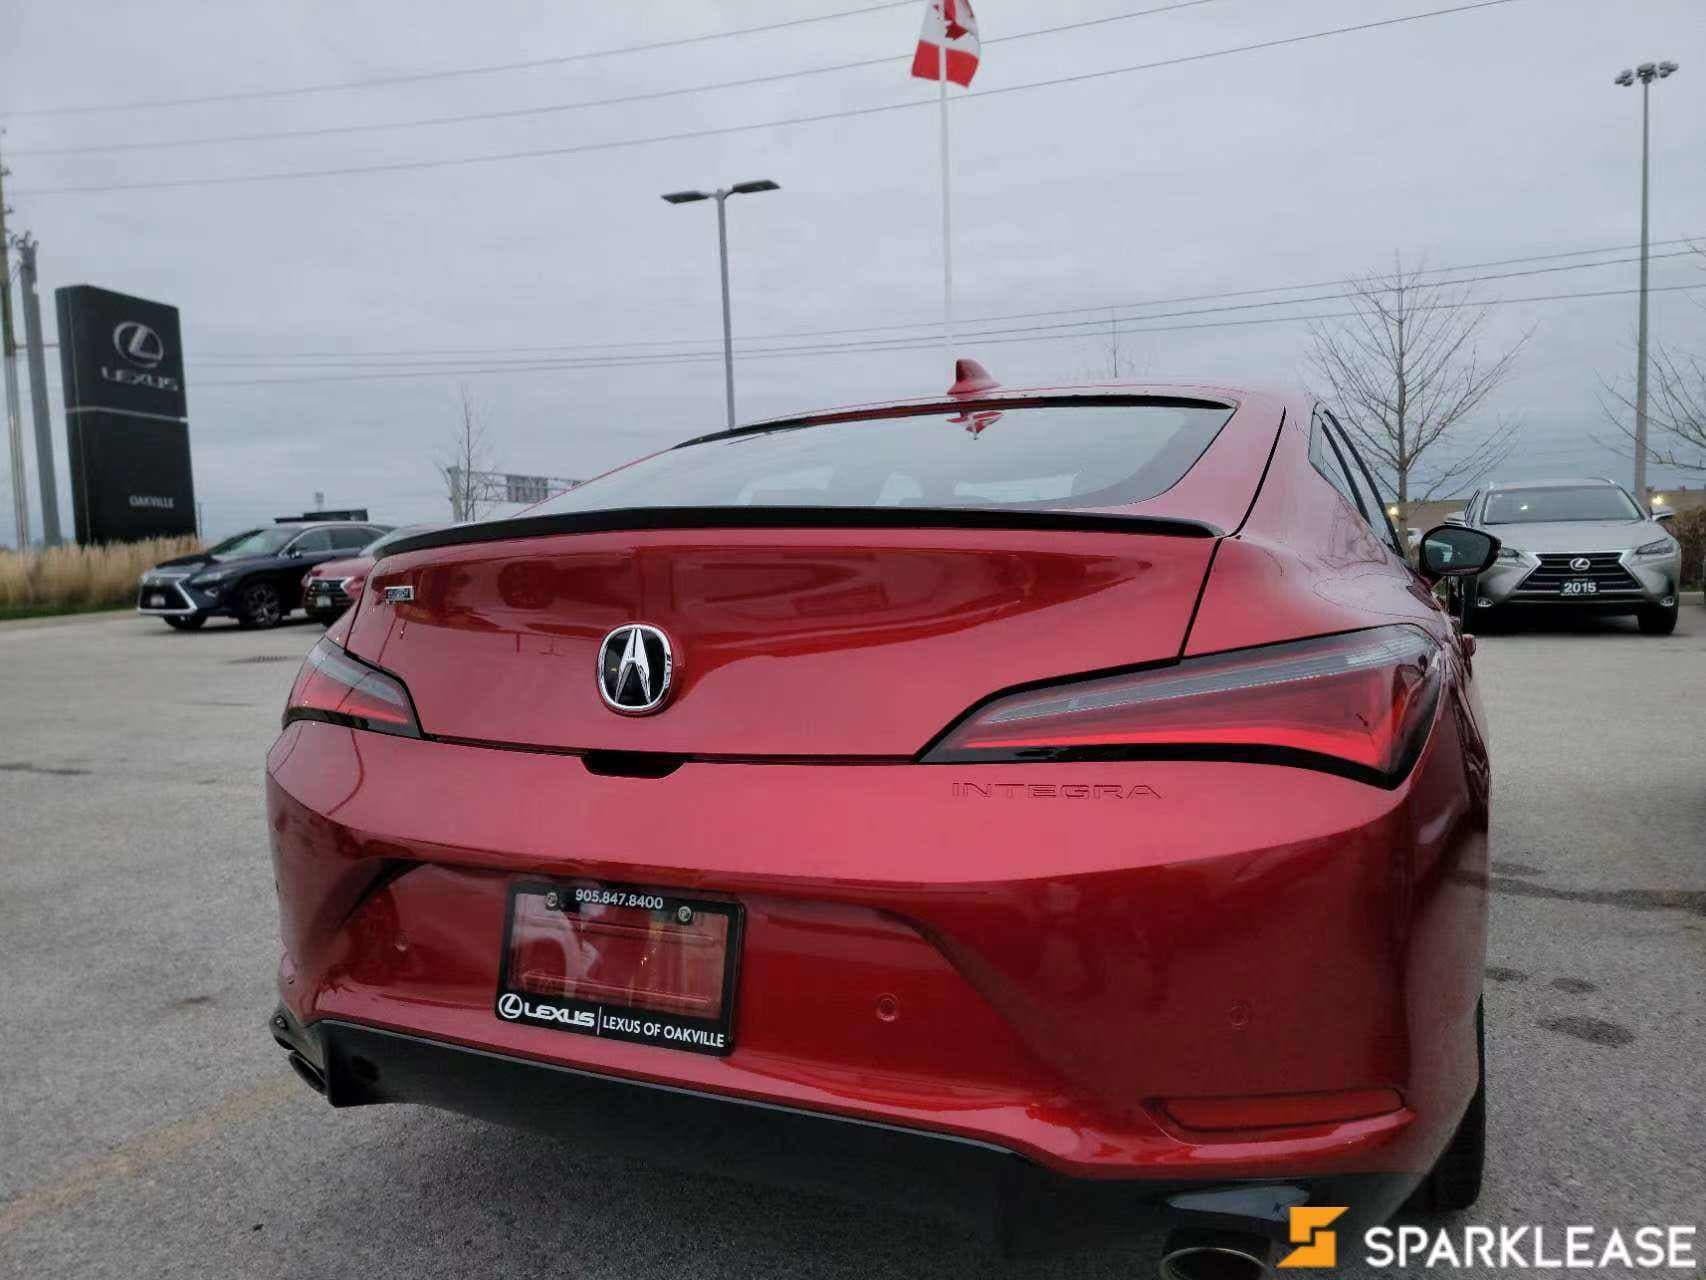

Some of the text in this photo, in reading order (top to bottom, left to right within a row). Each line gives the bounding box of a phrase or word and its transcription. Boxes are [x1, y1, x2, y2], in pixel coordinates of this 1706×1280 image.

[101, 366, 178, 391] LEXUS
[129, 495, 174, 508] OAKVILLE
[1564, 582, 1597, 593] 2015
[952, 782, 1162, 800] INTEGRA
[575, 888, 664, 910] 905.847.8400
[523, 1001, 596, 1027] LEXUS
[602, 1015, 725, 1048] LEXUS OF OAKVILLE
